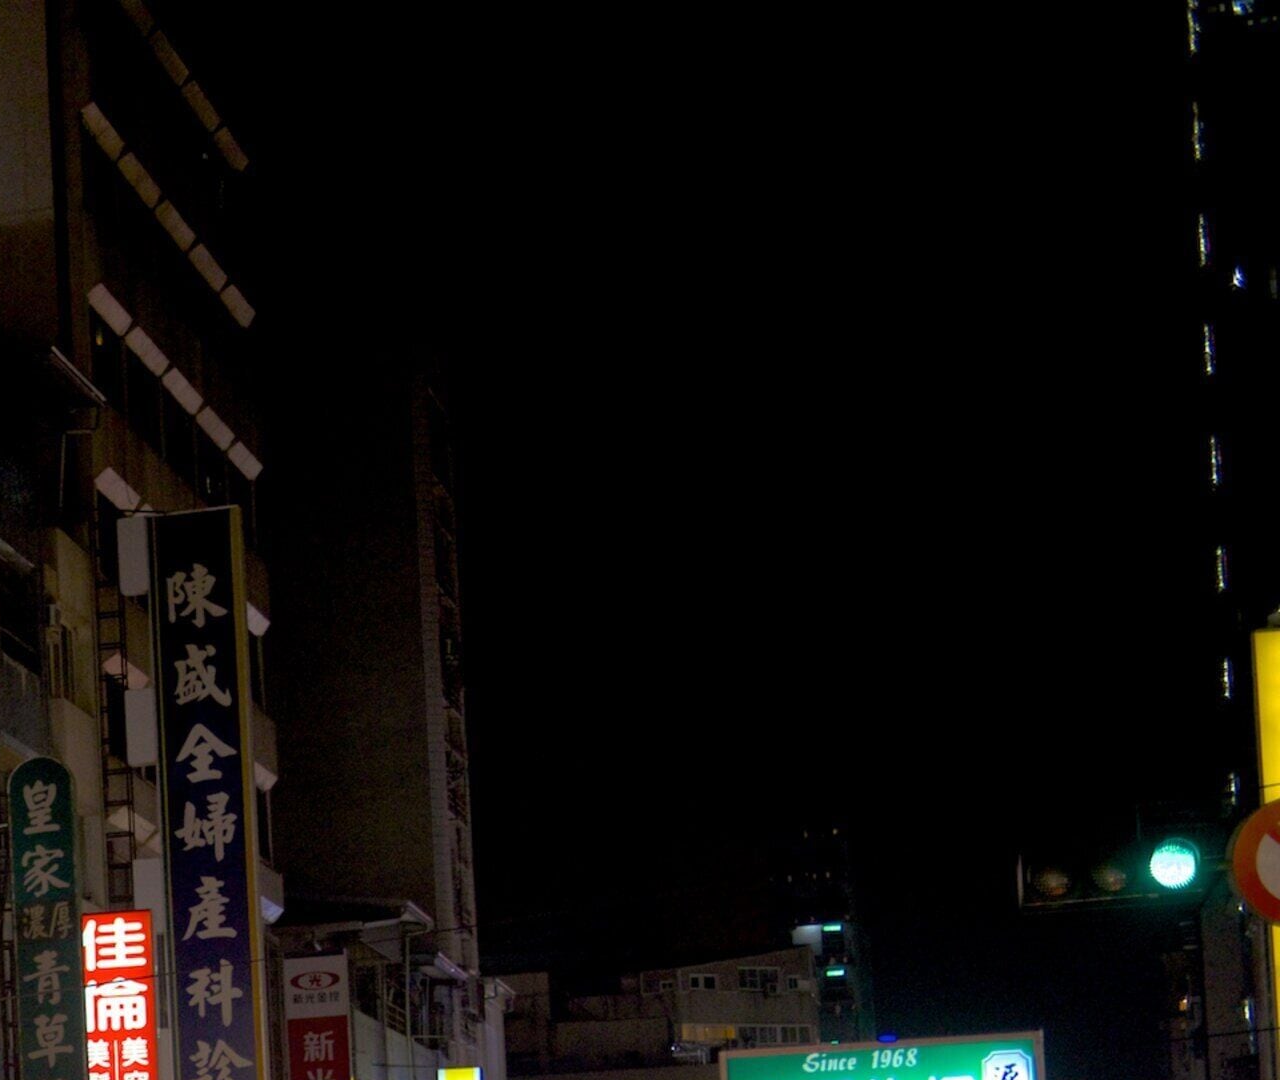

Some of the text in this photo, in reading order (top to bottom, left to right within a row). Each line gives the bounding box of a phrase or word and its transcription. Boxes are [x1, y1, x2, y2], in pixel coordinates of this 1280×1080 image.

[21, 779, 72, 898] 皇家
[82, 915, 148, 1034] 佳倫
[802, 1047, 918, 1073] Since 1968
